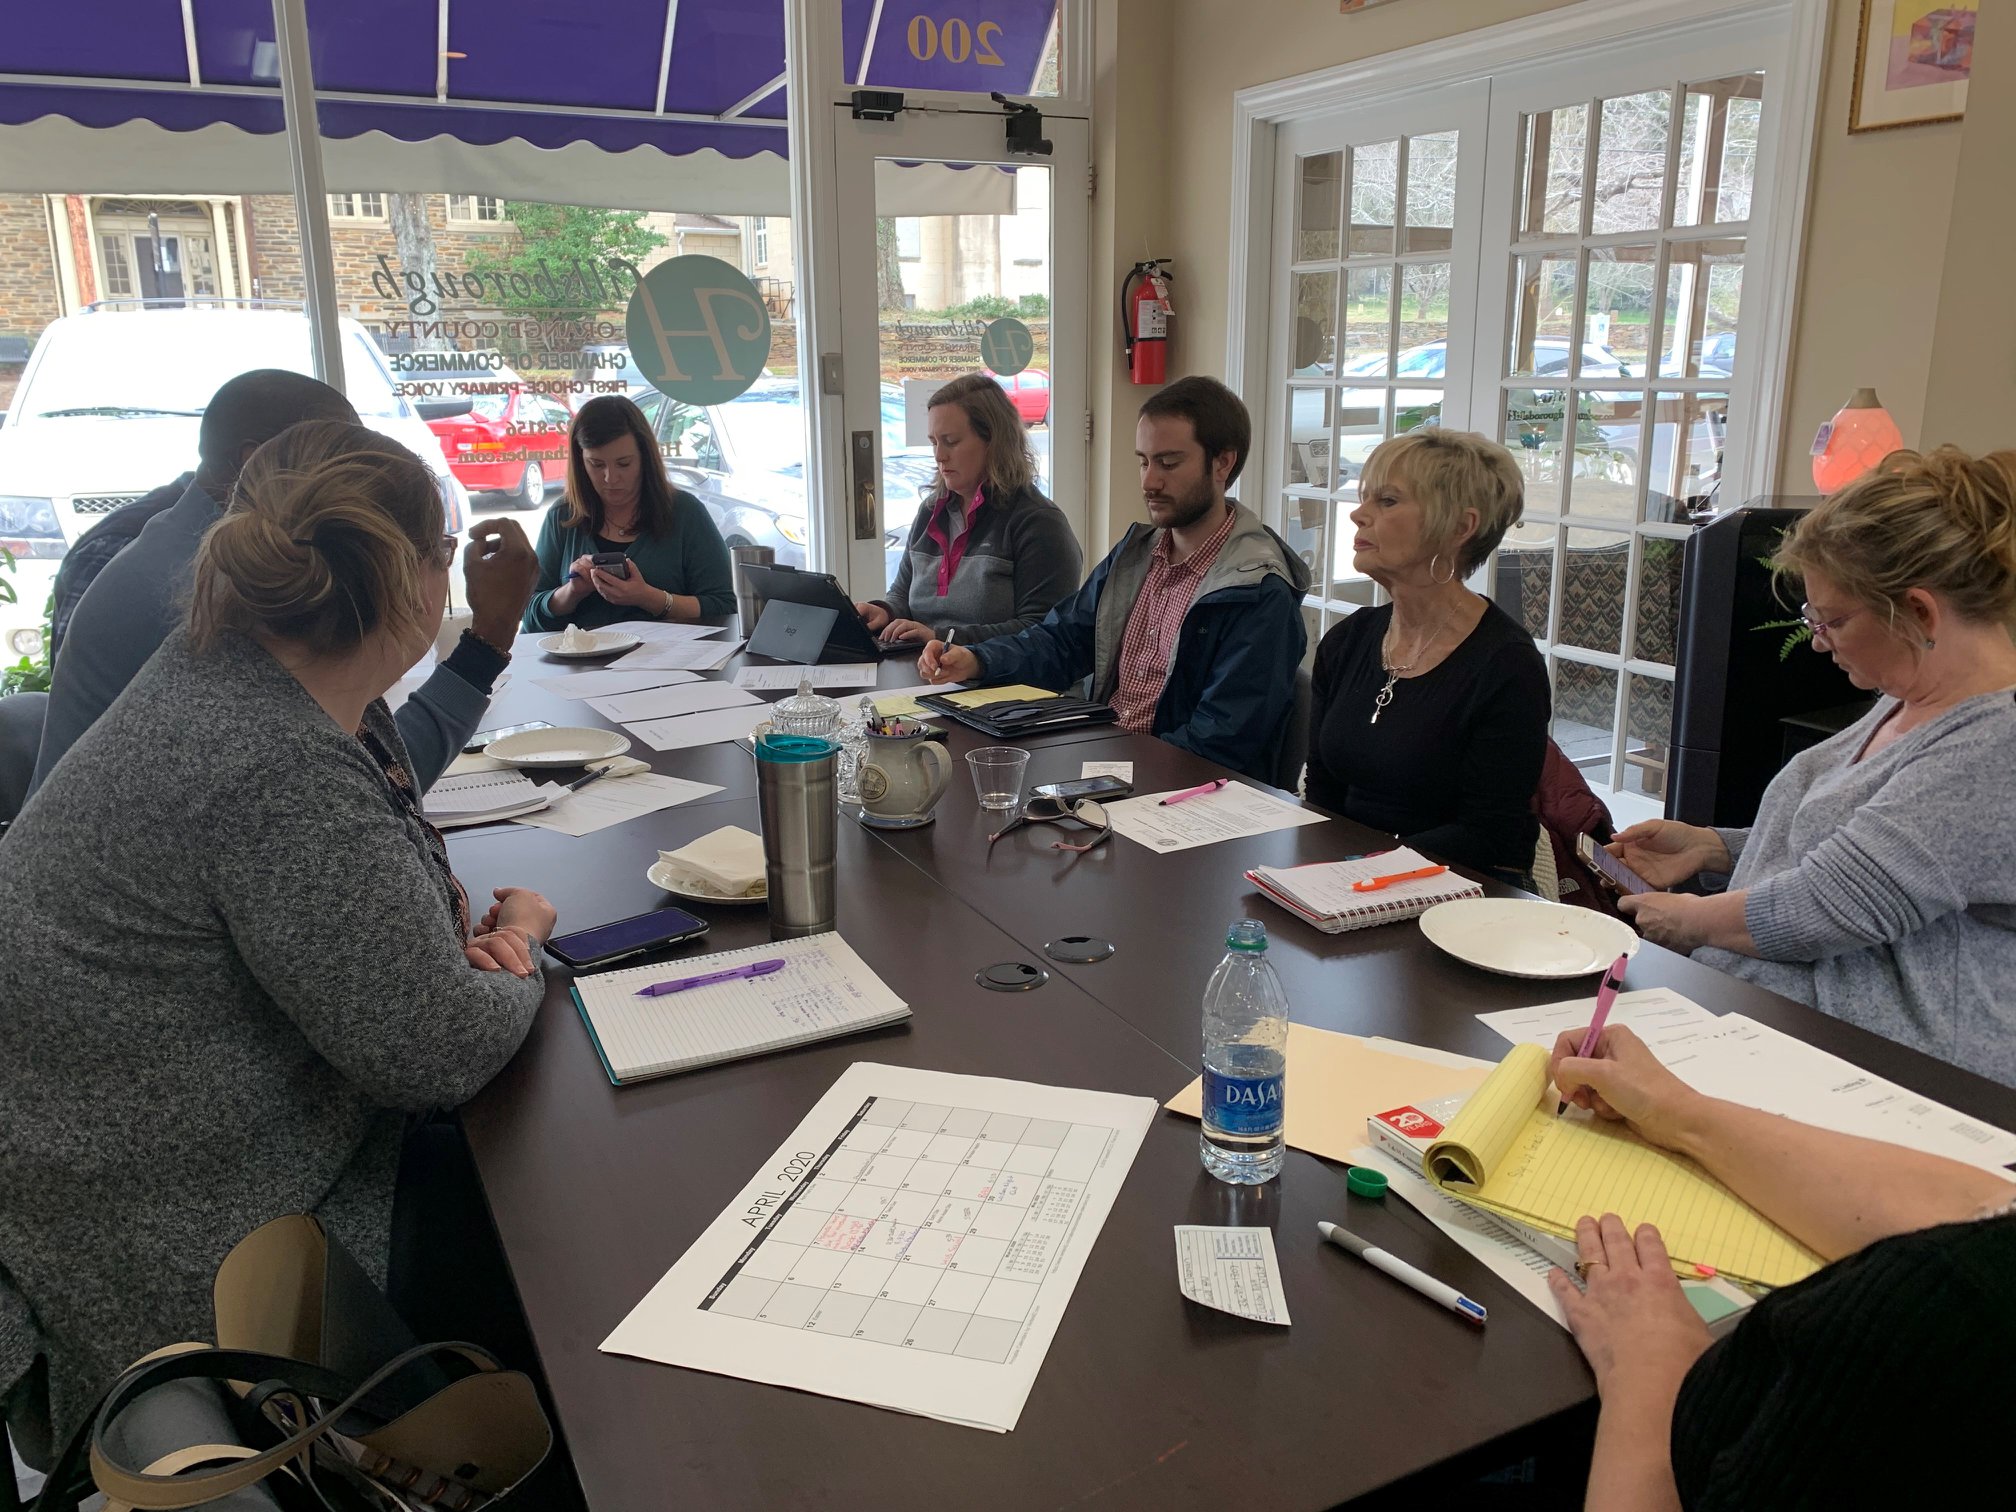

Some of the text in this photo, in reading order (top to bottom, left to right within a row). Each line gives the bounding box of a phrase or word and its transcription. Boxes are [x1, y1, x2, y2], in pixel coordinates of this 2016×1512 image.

[1389, 1112, 1424, 1128] 20
[709, 1283, 727, 1300] Sunday
[738, 1247, 755, 1264] Monday
[765, 1213, 782, 1230] Tuesday
[814, 1153, 830, 1170] Thursday
[741, 1190, 786, 1228] APRIL
[777, 1151, 815, 1182] 2020
[856, 1329, 864, 1337] 19
[880, 1290, 889, 1298] 20
[903, 1254, 912, 1262] 21
[924, 1220, 933, 1228] 22
[904, 1338, 914, 1346] 26
[928, 1299, 937, 1307] 27
[969, 1227, 978, 1235] 29
